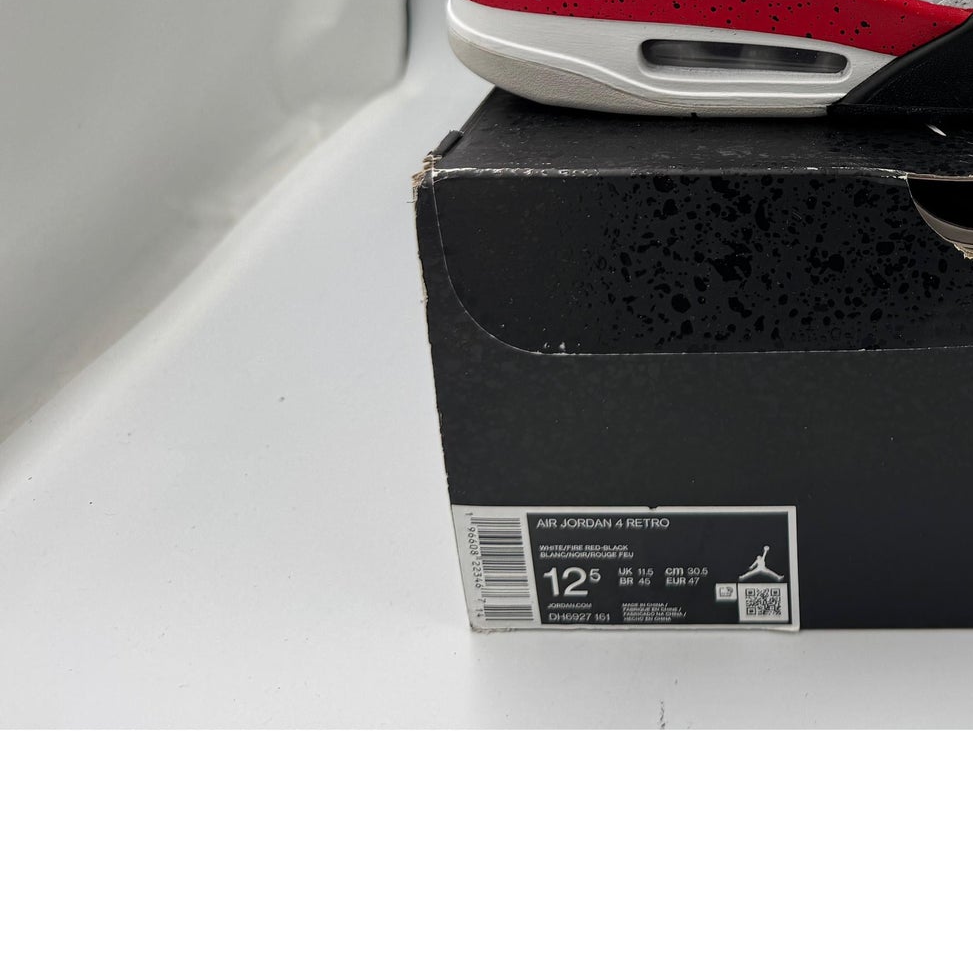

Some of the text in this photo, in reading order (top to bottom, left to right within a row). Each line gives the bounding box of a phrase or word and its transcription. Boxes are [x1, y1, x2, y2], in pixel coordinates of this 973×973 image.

[536, 518, 670, 529] AIR JORDAN 4 RETRO
[467, 527, 480, 556] 96608
[539, 544, 629, 552] WHITE/FIRE RED-BLACK
[540, 551, 634, 559] BLANC/NOIR/ROUGE FEU
[618, 567, 654, 577] UK 11.5
[664, 567, 708, 576] cm 30.5
[619, 577, 651, 586] BR 45
[666, 576, 700, 586] EUR 47
[547, 602, 593, 610] JORDAN.COM
[549, 612, 611, 622] DH6927 161
